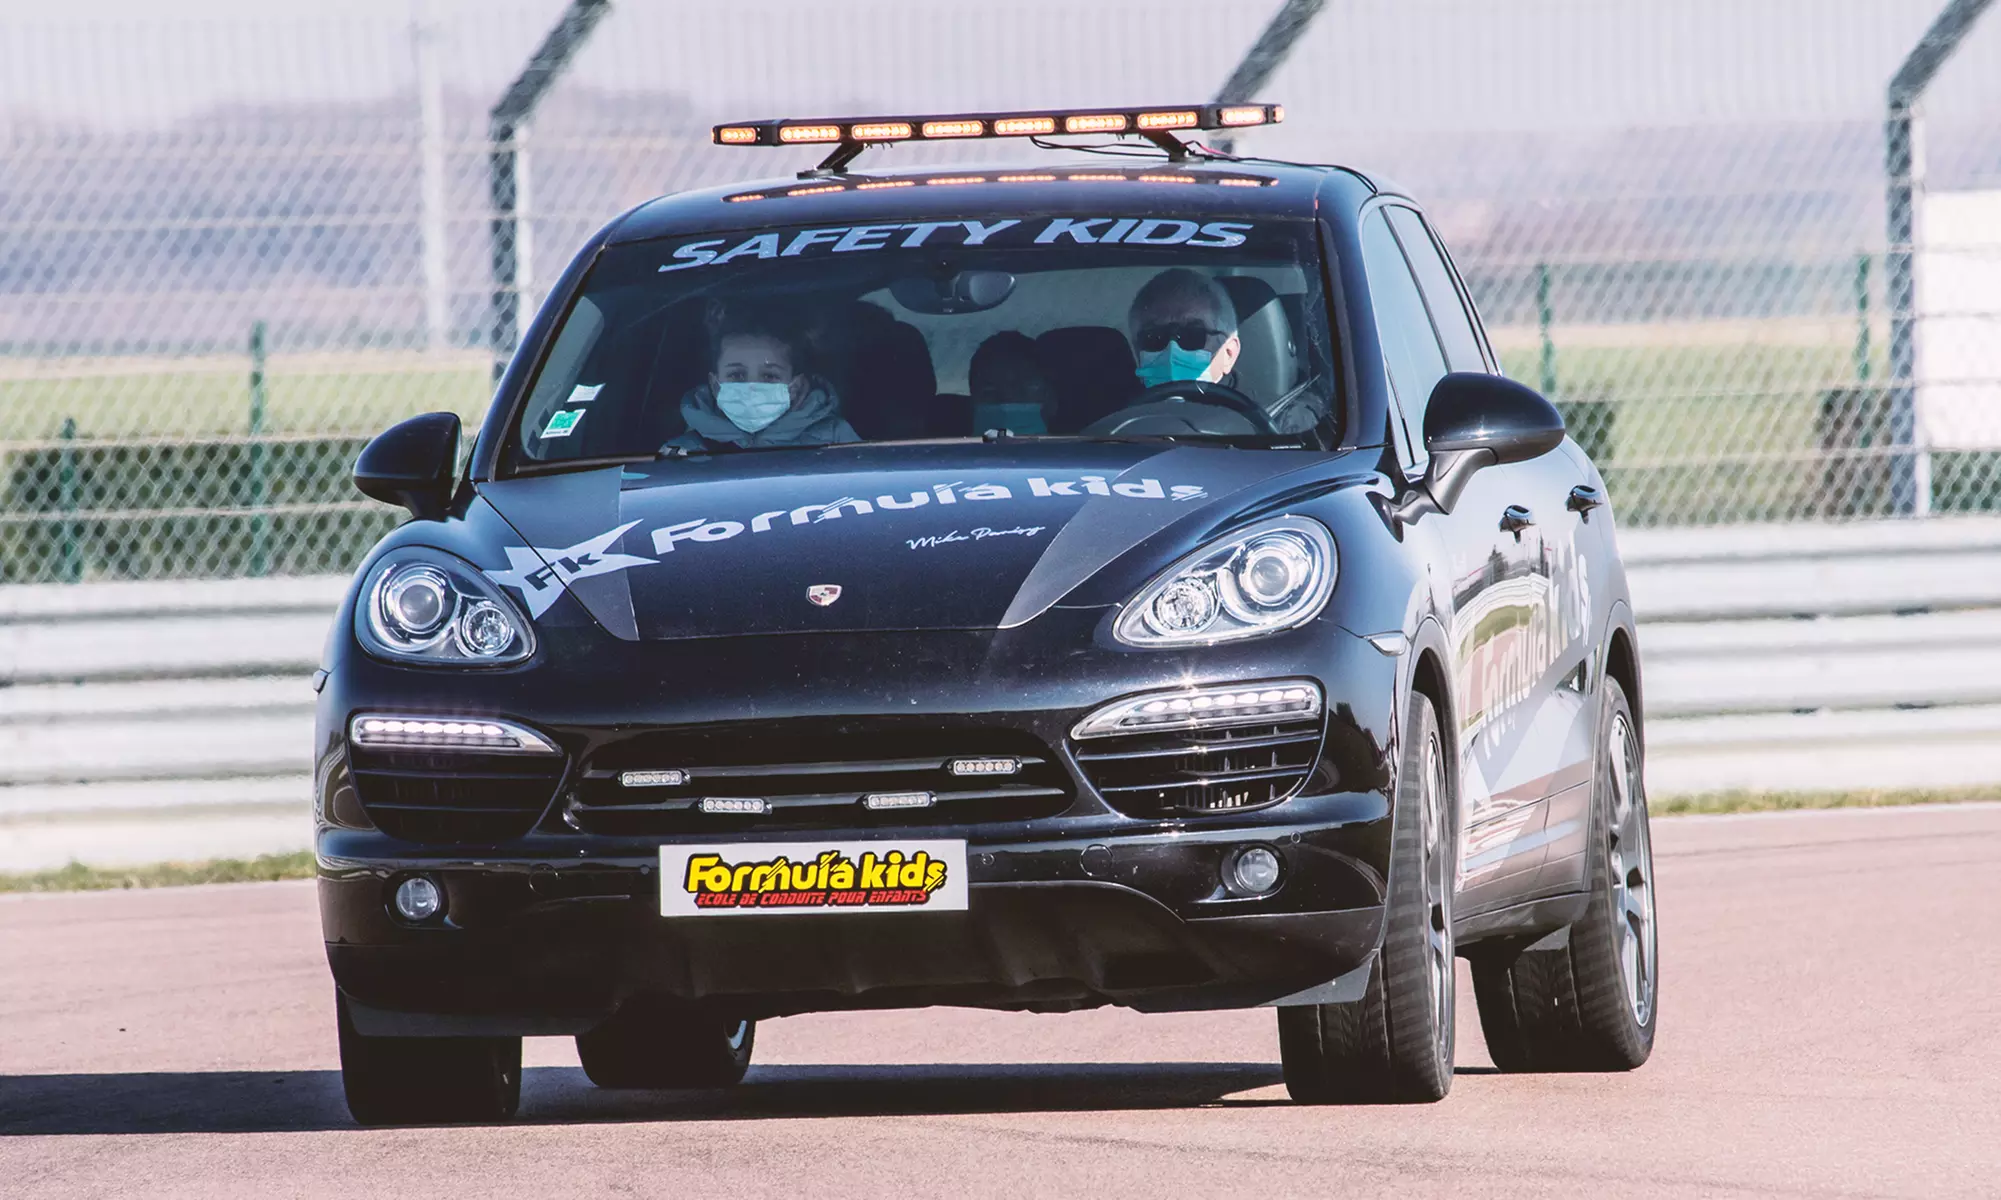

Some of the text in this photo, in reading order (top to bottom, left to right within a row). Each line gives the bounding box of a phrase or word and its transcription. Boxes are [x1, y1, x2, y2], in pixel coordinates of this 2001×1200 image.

[657, 217, 1255, 273] SAFETY KIDS
[523, 475, 1210, 592] FK Formula kids
[685, 849, 947, 894] Formula kids
[696, 889, 928, 906] ECOLE DE CONDUITE POUR ENFANTS
